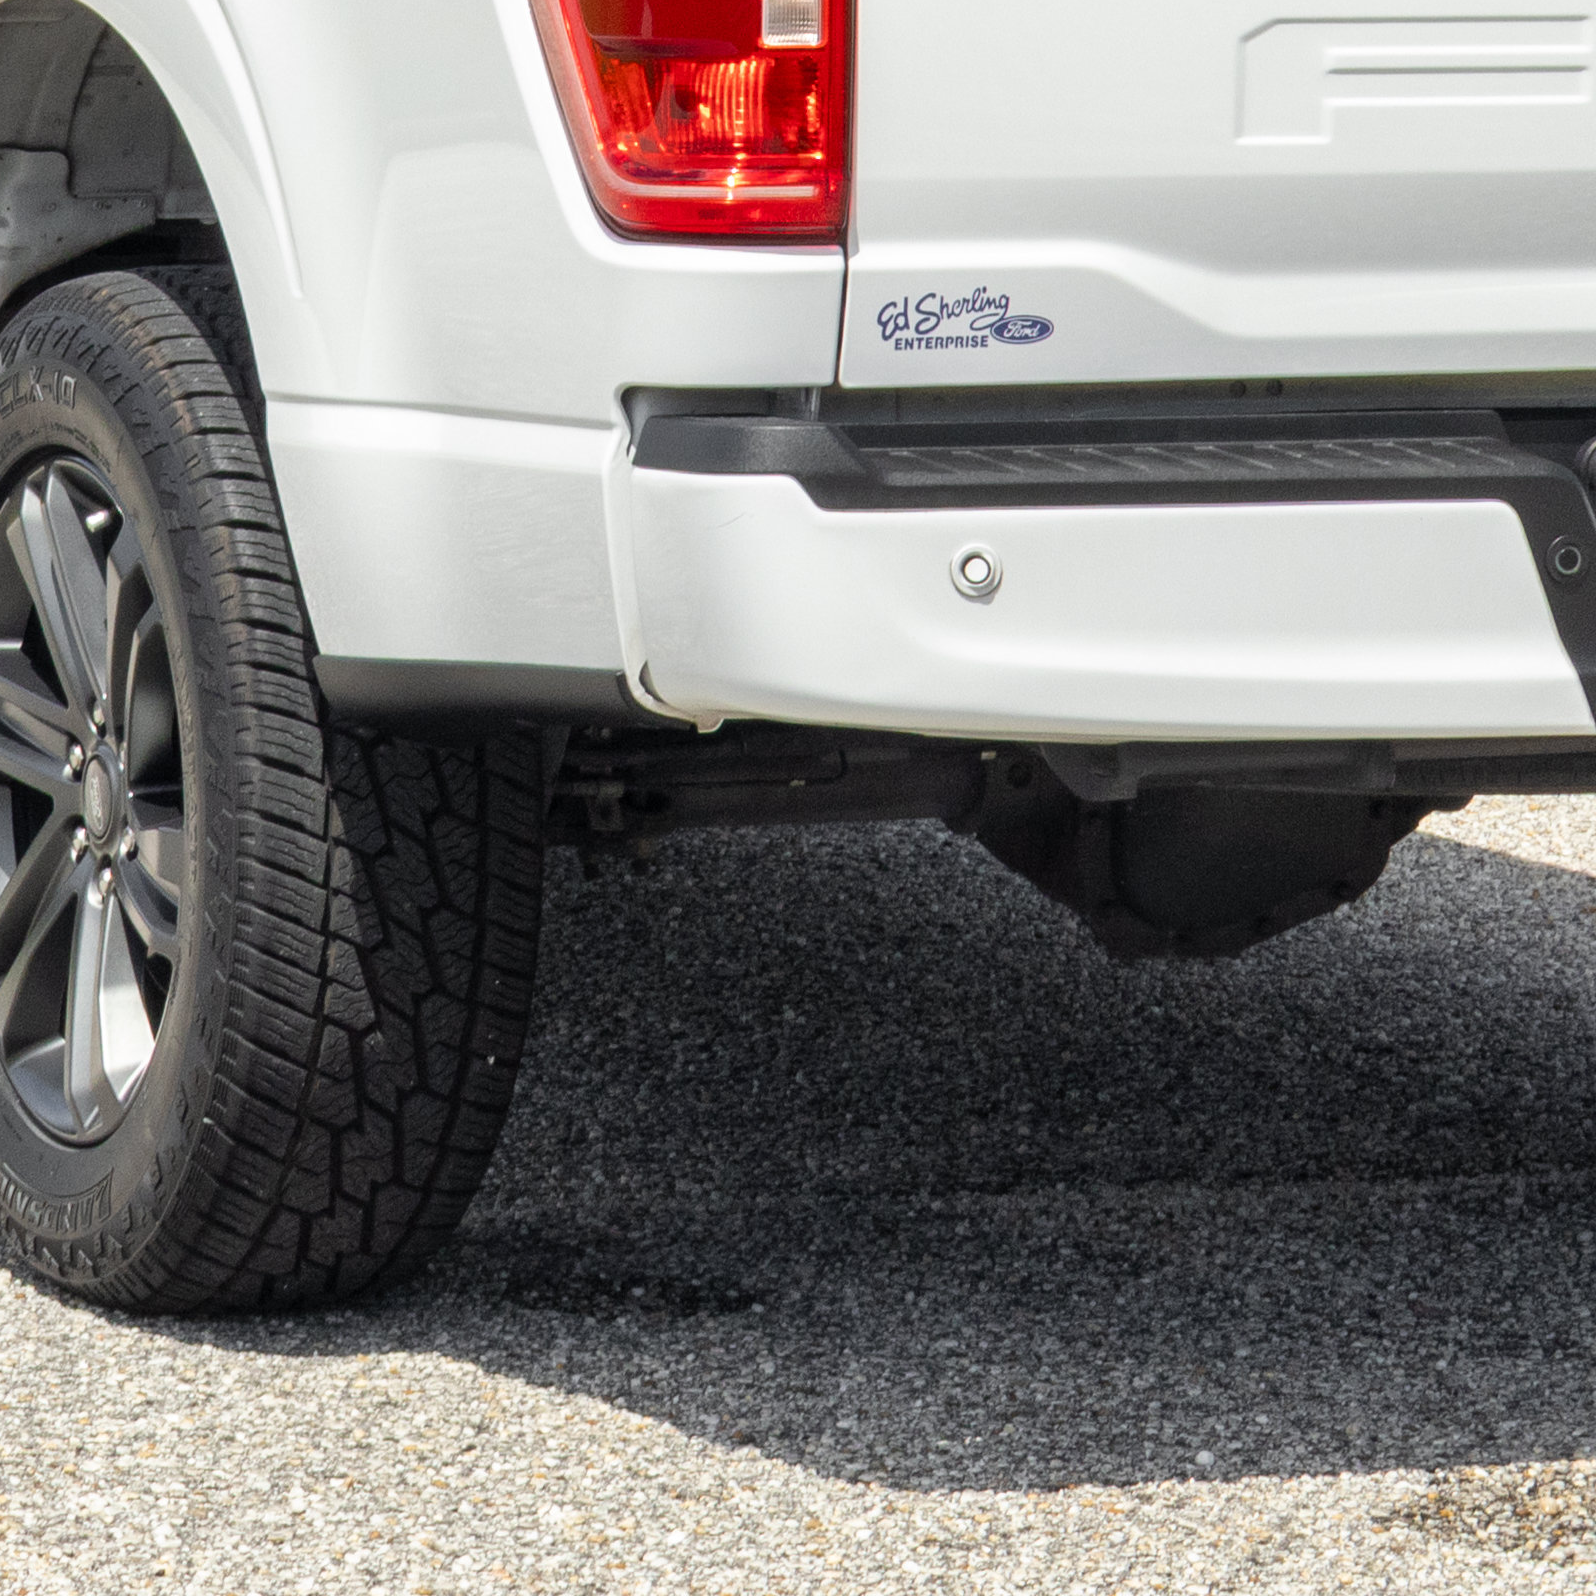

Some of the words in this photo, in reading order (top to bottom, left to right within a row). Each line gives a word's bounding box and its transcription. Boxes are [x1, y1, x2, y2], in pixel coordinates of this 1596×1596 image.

[877, 296, 910, 341] Ed
[914, 286, 1009, 334] Sherling
[1003, 321, 1040, 338] Ford
[894, 336, 989, 351] ENTERPRISE
